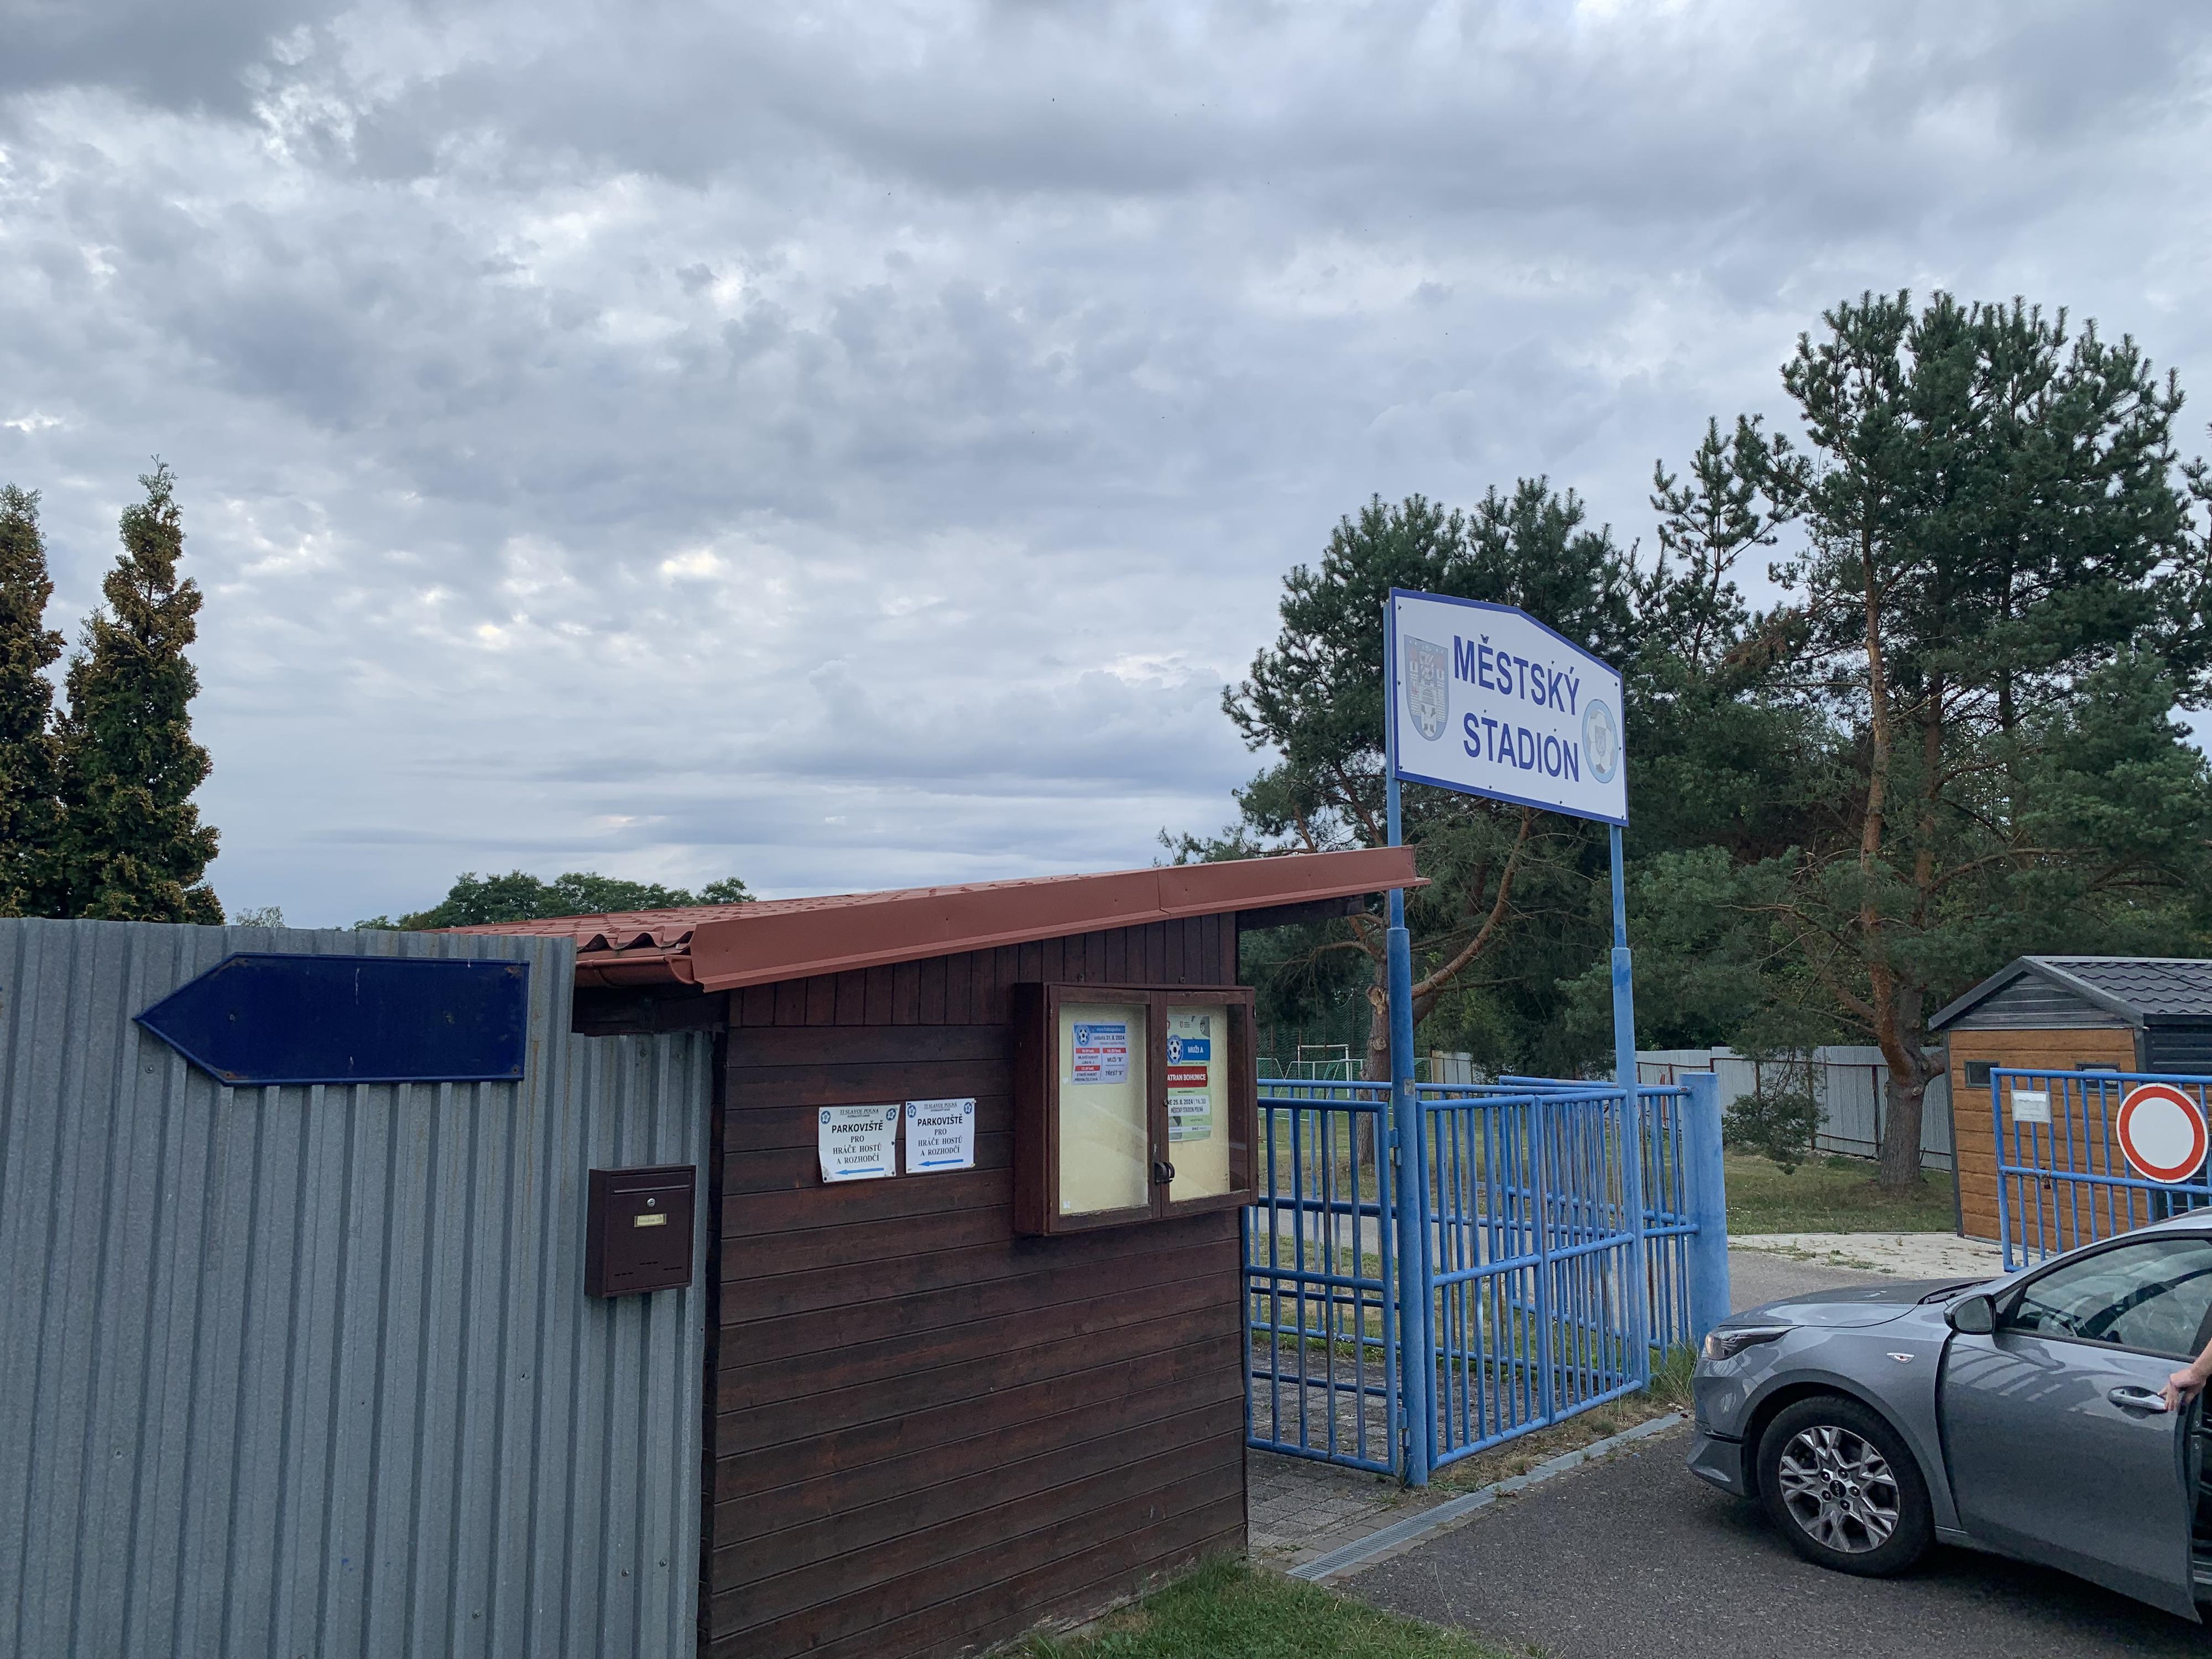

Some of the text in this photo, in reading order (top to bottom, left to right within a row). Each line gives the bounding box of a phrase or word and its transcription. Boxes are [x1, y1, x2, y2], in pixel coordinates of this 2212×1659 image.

[1454, 634, 1580, 716] MĚSTSKÝ
[1187, 1045, 1199, 1053] MUŽI
[832, 1120, 884, 1133] PARKOVIŠTĚ
[917, 1114, 963, 1127] PARKOVIŠTĚ
[918, 1135, 963, 1147] HRÁČE HOSTŮ
[833, 1142, 881, 1155] HRÁČE HOSTŮ
[928, 1145, 959, 1156] ROZHODČÍ
[844, 1152, 879, 1164] ROZHODČÍ
